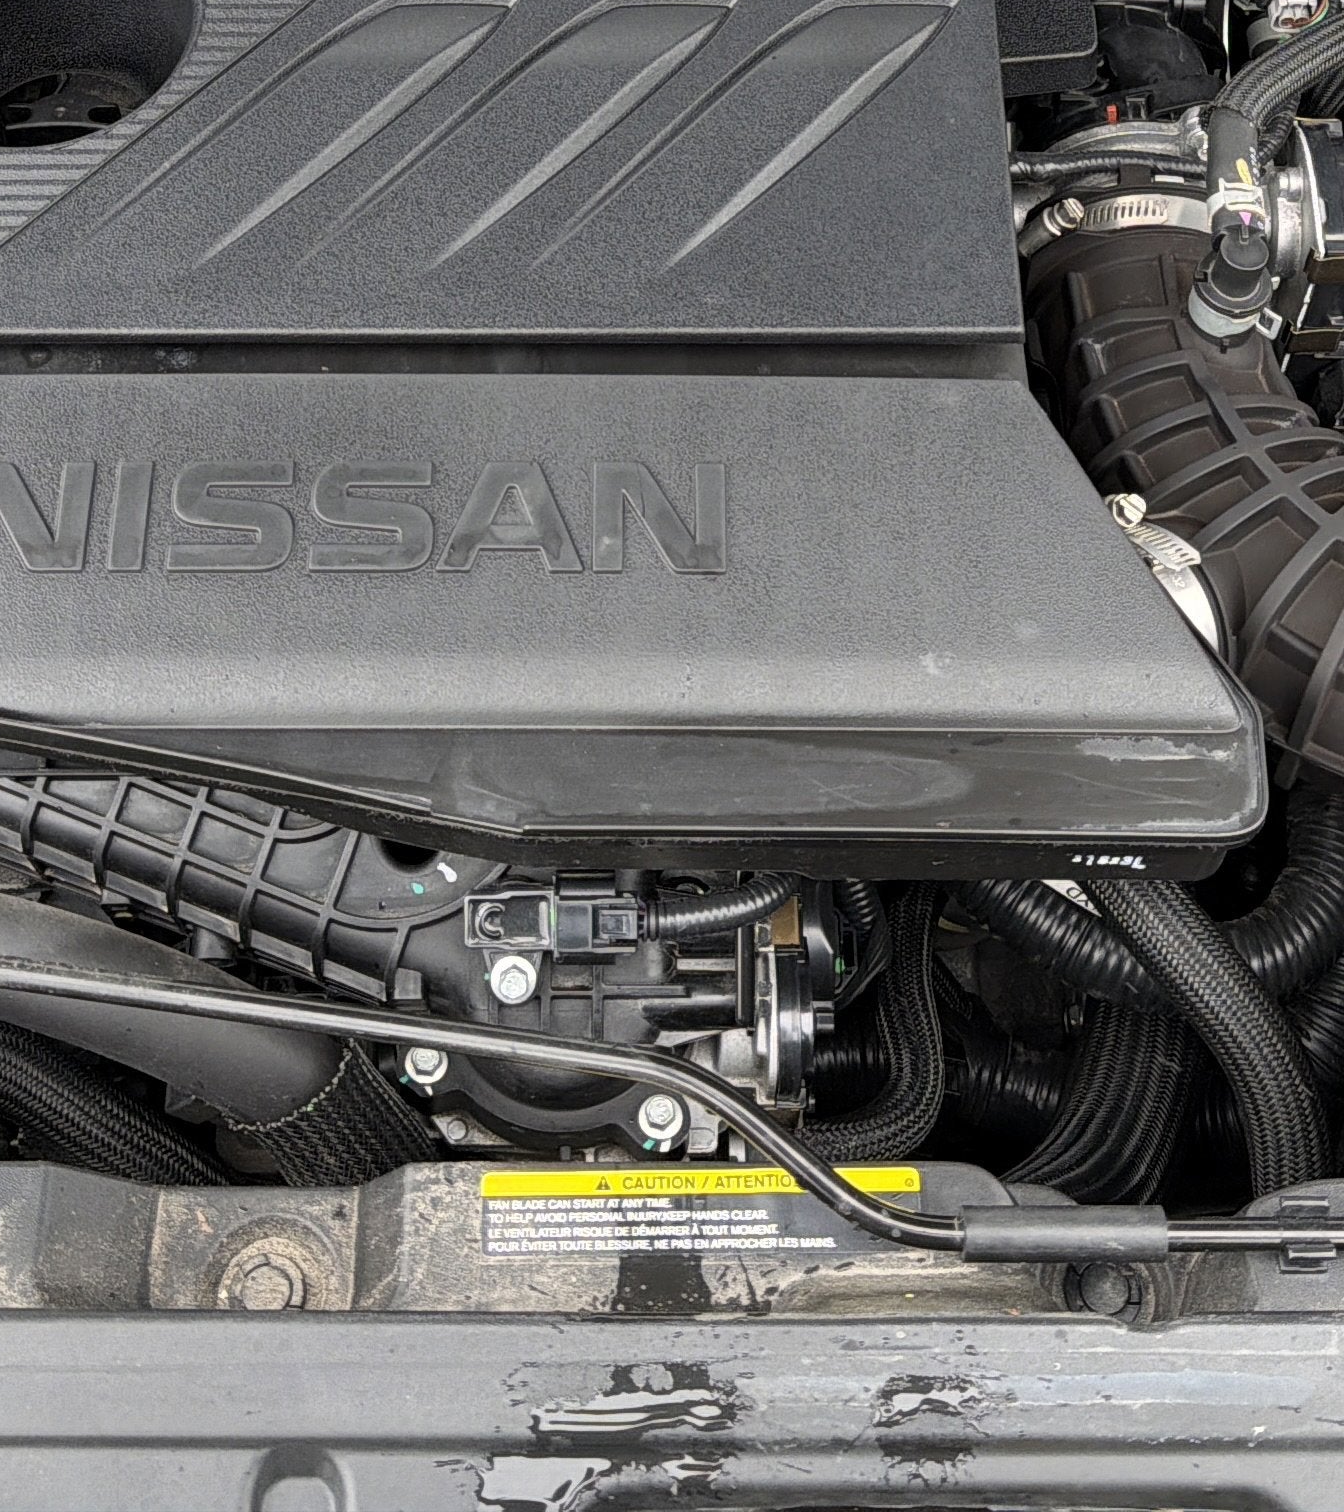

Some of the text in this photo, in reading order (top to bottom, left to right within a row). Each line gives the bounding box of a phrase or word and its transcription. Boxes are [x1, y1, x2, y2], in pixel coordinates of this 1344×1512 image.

[622, 1174, 800, 1190] CAUTION / ATTENTIO
[489, 1201, 510, 1210] FAN
[512, 1200, 545, 1210] BLADE
[548, 1200, 570, 1208] CAN
[573, 1200, 604, 1208] START
[607, 1200, 619, 1208] AT
[622, 1199, 644, 1208] ANY
[489, 1214, 503, 1223] TO
[506, 1213, 533, 1223] HELP
[535, 1213, 566, 1223] AVOID
[569, 1212, 624, 1222] PERSONAL
[692, 1210, 730, 1221] HANDS
[732, 1210, 770, 1220] CLEAR.
[489, 1224, 780, 1238] LE VENTILATEUR RISQUE DE DÉMARRER À TOUT MOMENT.
[489, 1237, 838, 1252] POUR ÉVITER TOUTE BLESSURE, NE PAS EN APPROCHER LES MAINS.
